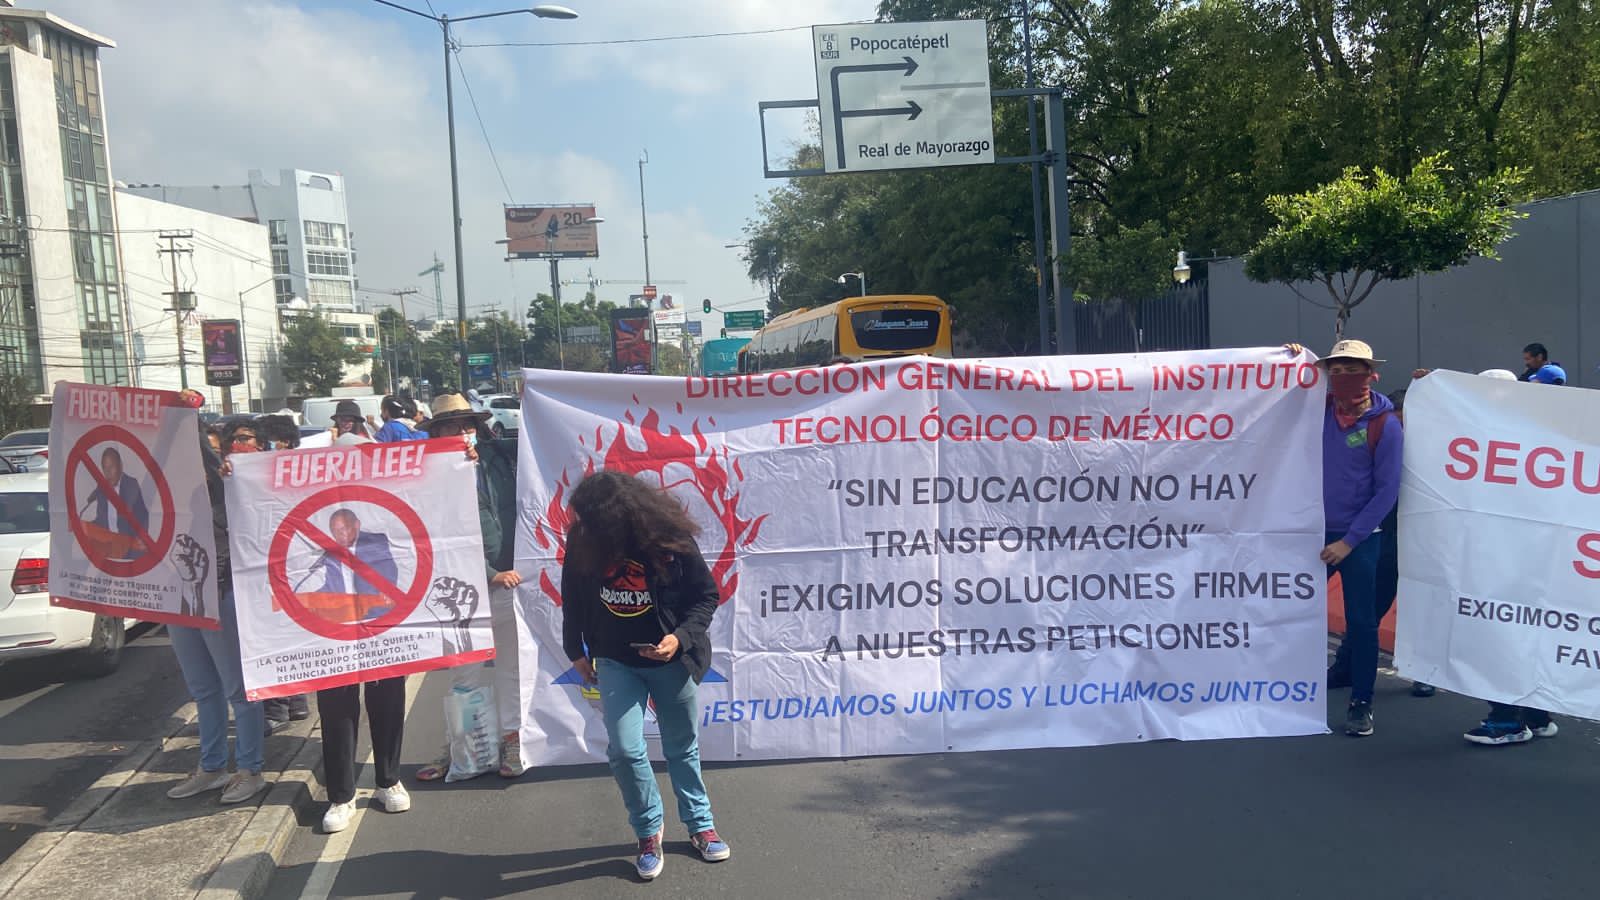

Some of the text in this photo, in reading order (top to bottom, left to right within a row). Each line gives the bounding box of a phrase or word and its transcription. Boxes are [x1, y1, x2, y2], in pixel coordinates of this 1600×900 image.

[826, 41, 833, 51] 8
[850, 33, 949, 54] Popocatépetl
[858, 140, 990, 158] Real de Mayorazgo
[897, 362, 1062, 392] GENERAL
[1071, 367, 1134, 392] DEL
[1152, 362, 1319, 391] INSTITUTO
[68, 387, 161, 427] FUERA LEE!
[772, 406, 1234, 445] TECNOLÓGICO DE MÉXICO
[274, 443, 426, 488] FUERA LEE!
[912, 469, 1120, 505] EDUCACIÓN
[1129, 475, 1180, 501] NO
[1189, 473, 1257, 501] HAY
[635, 591, 652, 605] PA
[760, 571, 1315, 617] ¡EXIGIMOS SOLUCIONES FIRMES
[1458, 597, 1579, 632] EXIGIMOS
[256, 658, 273, 669] ¡LA
[275, 647, 334, 664] COMUNIDAD
[352, 642, 367, 651] NO
[370, 640, 380, 649] TE
[382, 635, 415, 647] QUIERE
[426, 631, 435, 639] TI
[822, 621, 1250, 662] A NUESTRAS PETICIONES!
[276, 665, 287, 674] NI
[290, 663, 297, 672] A
[300, 661, 312, 670] TU
[315, 655, 350, 668] EQUIPO
[277, 653, 420, 683] RENUNCIA NO ES NEGOCIABLE!
[703, 680, 1318, 727] ¡ESTUDIAMOS JUNTOS Y LUCHAMOS JUNTOS!
